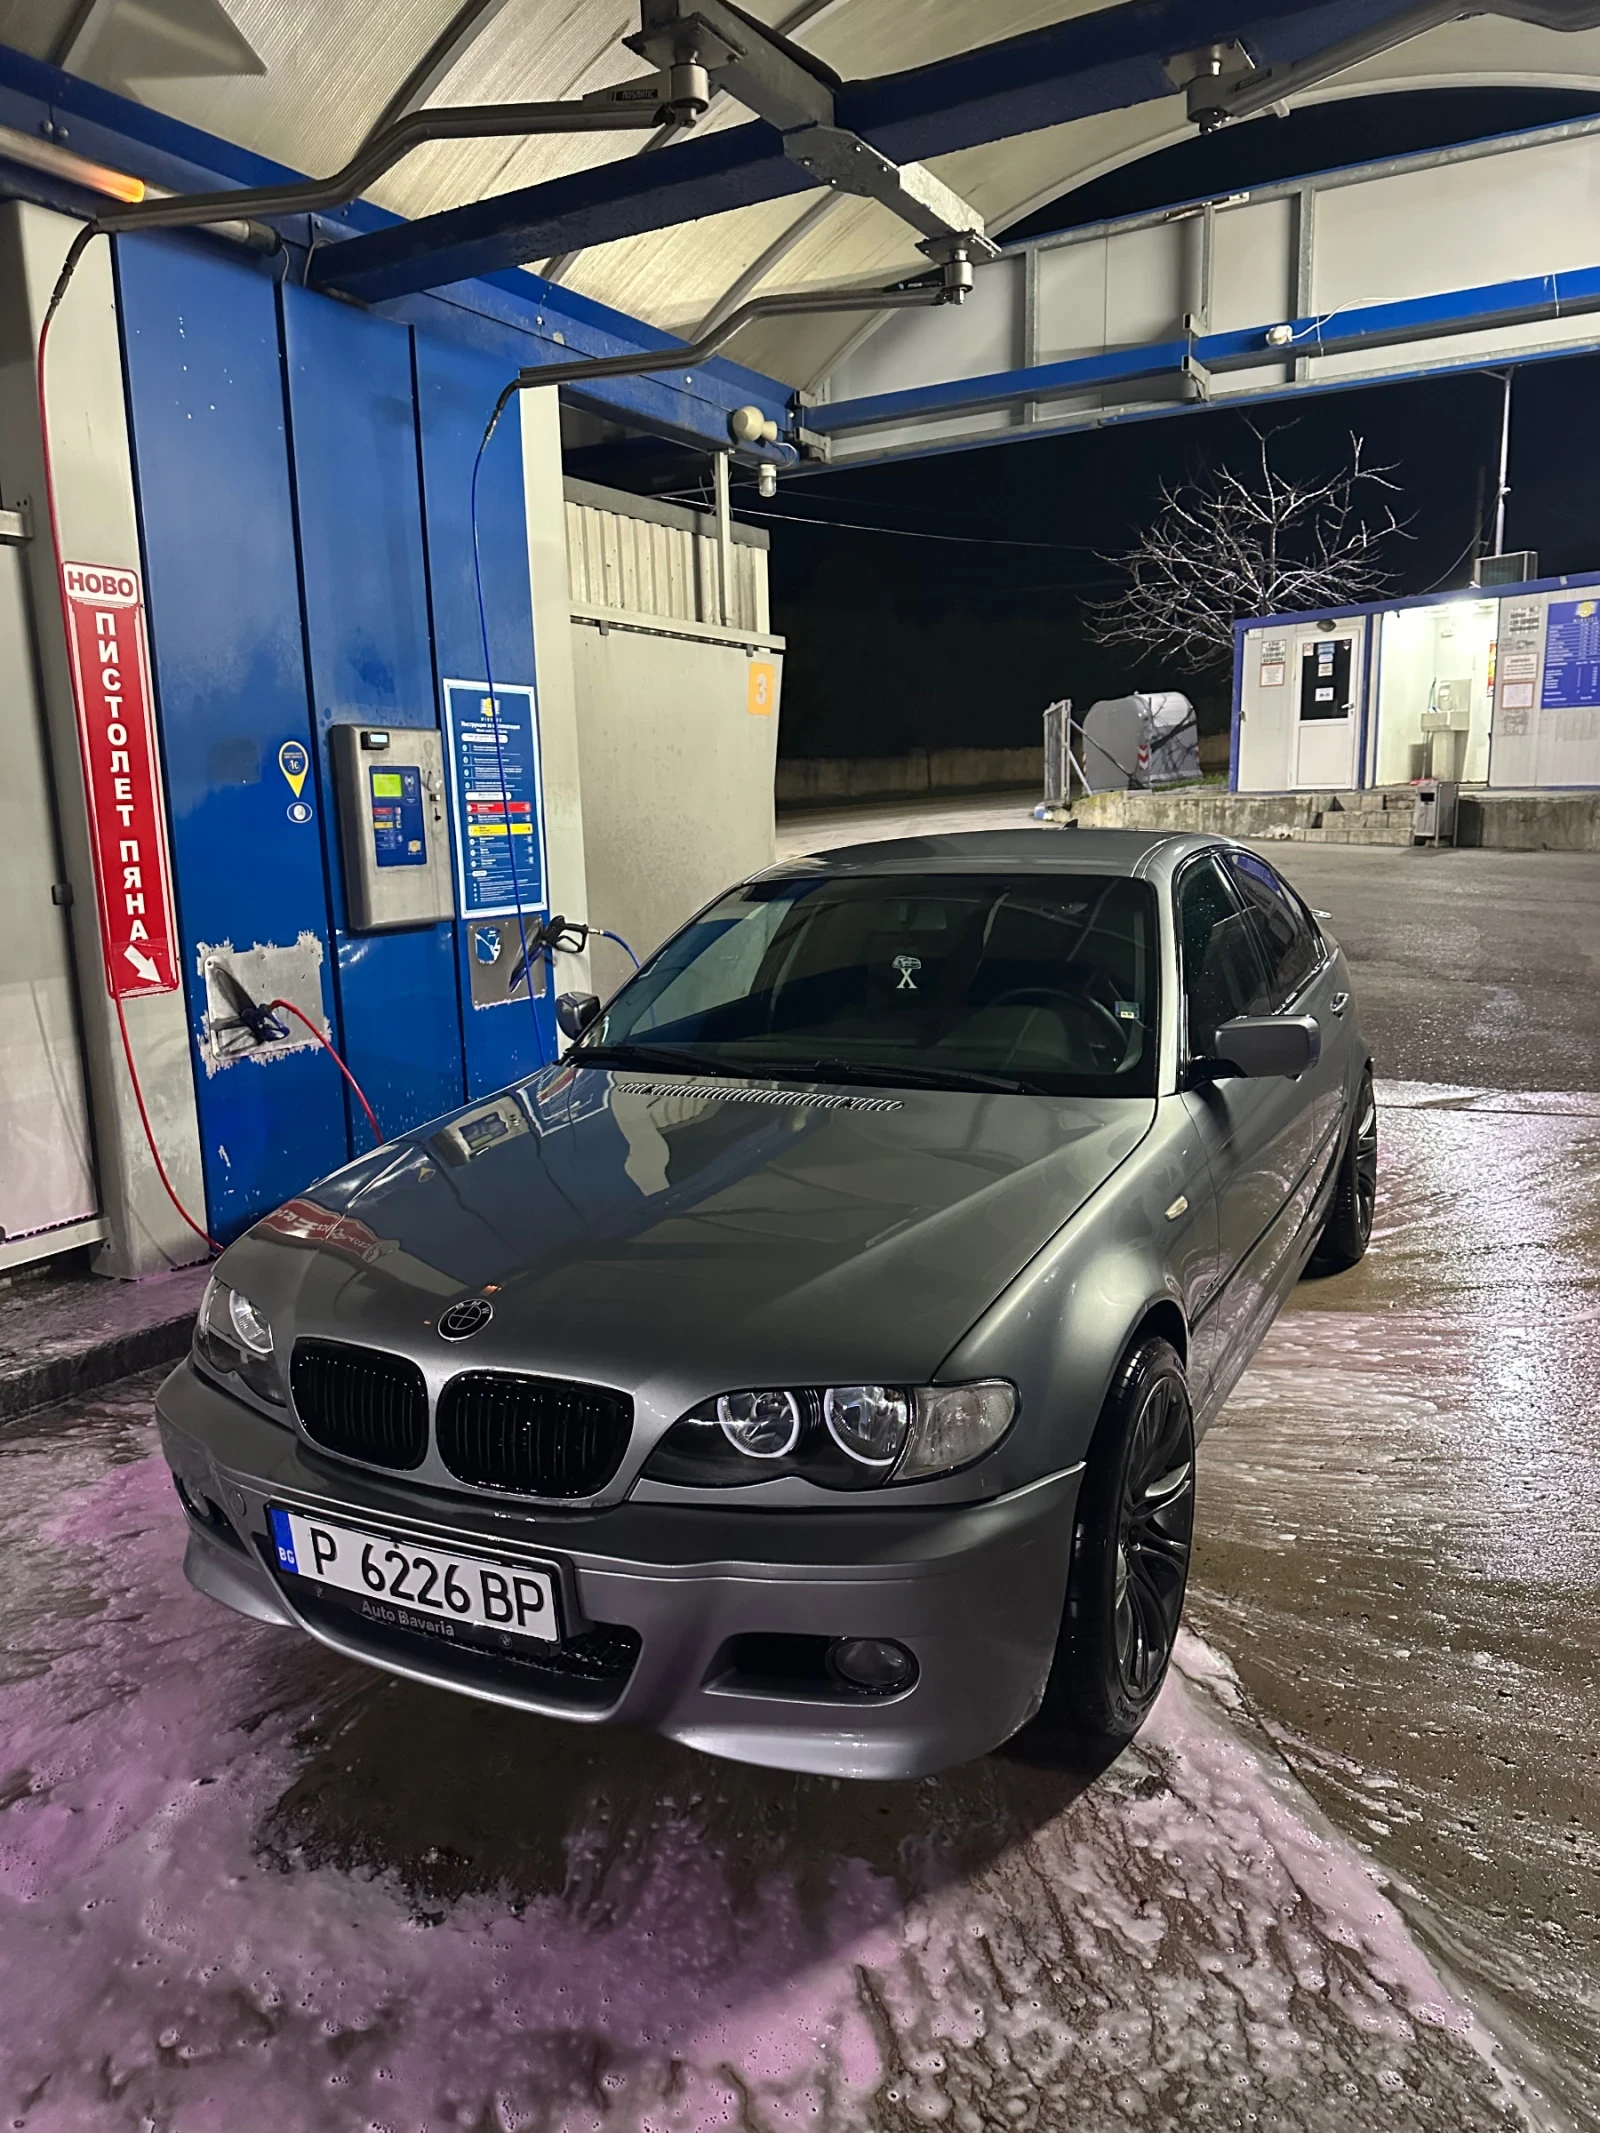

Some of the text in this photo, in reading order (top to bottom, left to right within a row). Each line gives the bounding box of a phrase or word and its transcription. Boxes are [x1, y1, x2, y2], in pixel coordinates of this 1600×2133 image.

[67, 571, 134, 597] НОВО
[756, 673, 767, 704] 3
[95, 611, 134, 827] ПИСТОЛЕТ
[119, 840, 149, 941] ПЯНА
[278, 1547, 295, 1564] BG
[310, 1527, 544, 1627] P 6226 BP
[362, 1600, 455, 1637] Auto Bavaria
